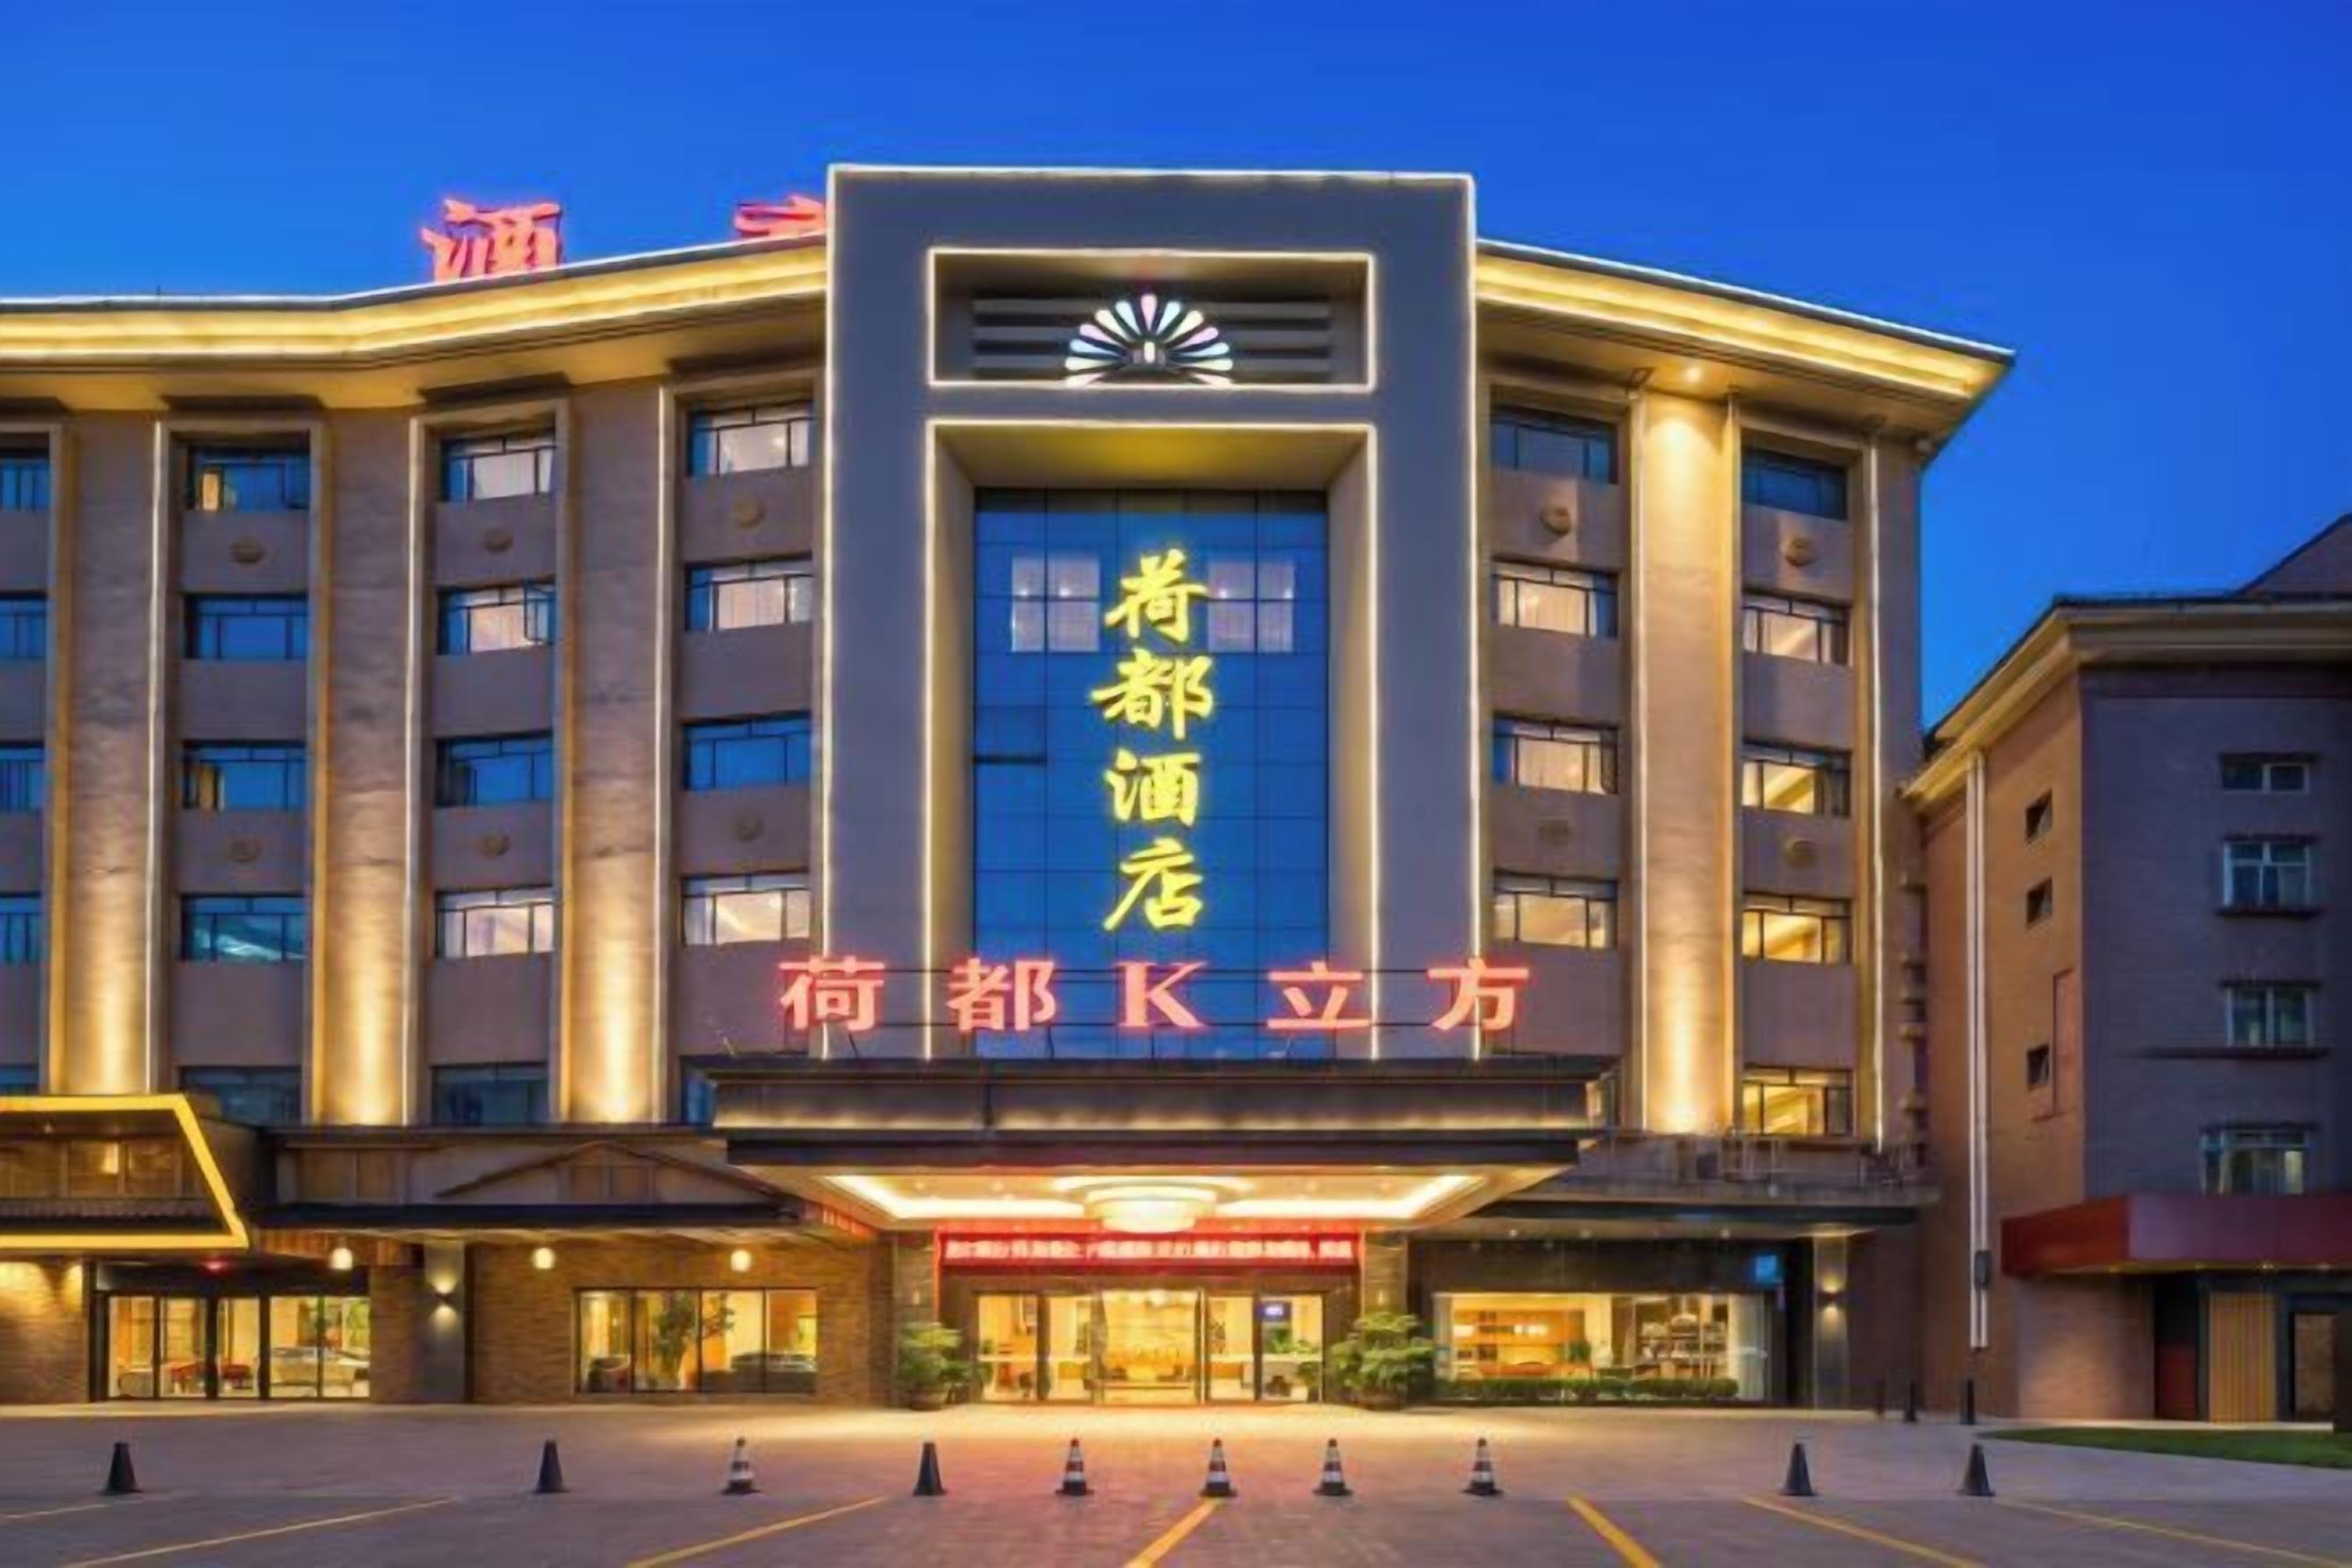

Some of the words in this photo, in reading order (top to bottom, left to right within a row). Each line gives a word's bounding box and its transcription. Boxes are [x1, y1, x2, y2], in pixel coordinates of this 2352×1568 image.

[1092, 549, 1214, 930] 荷都酒店
[778, 954, 1534, 1033] 荷都K立方
